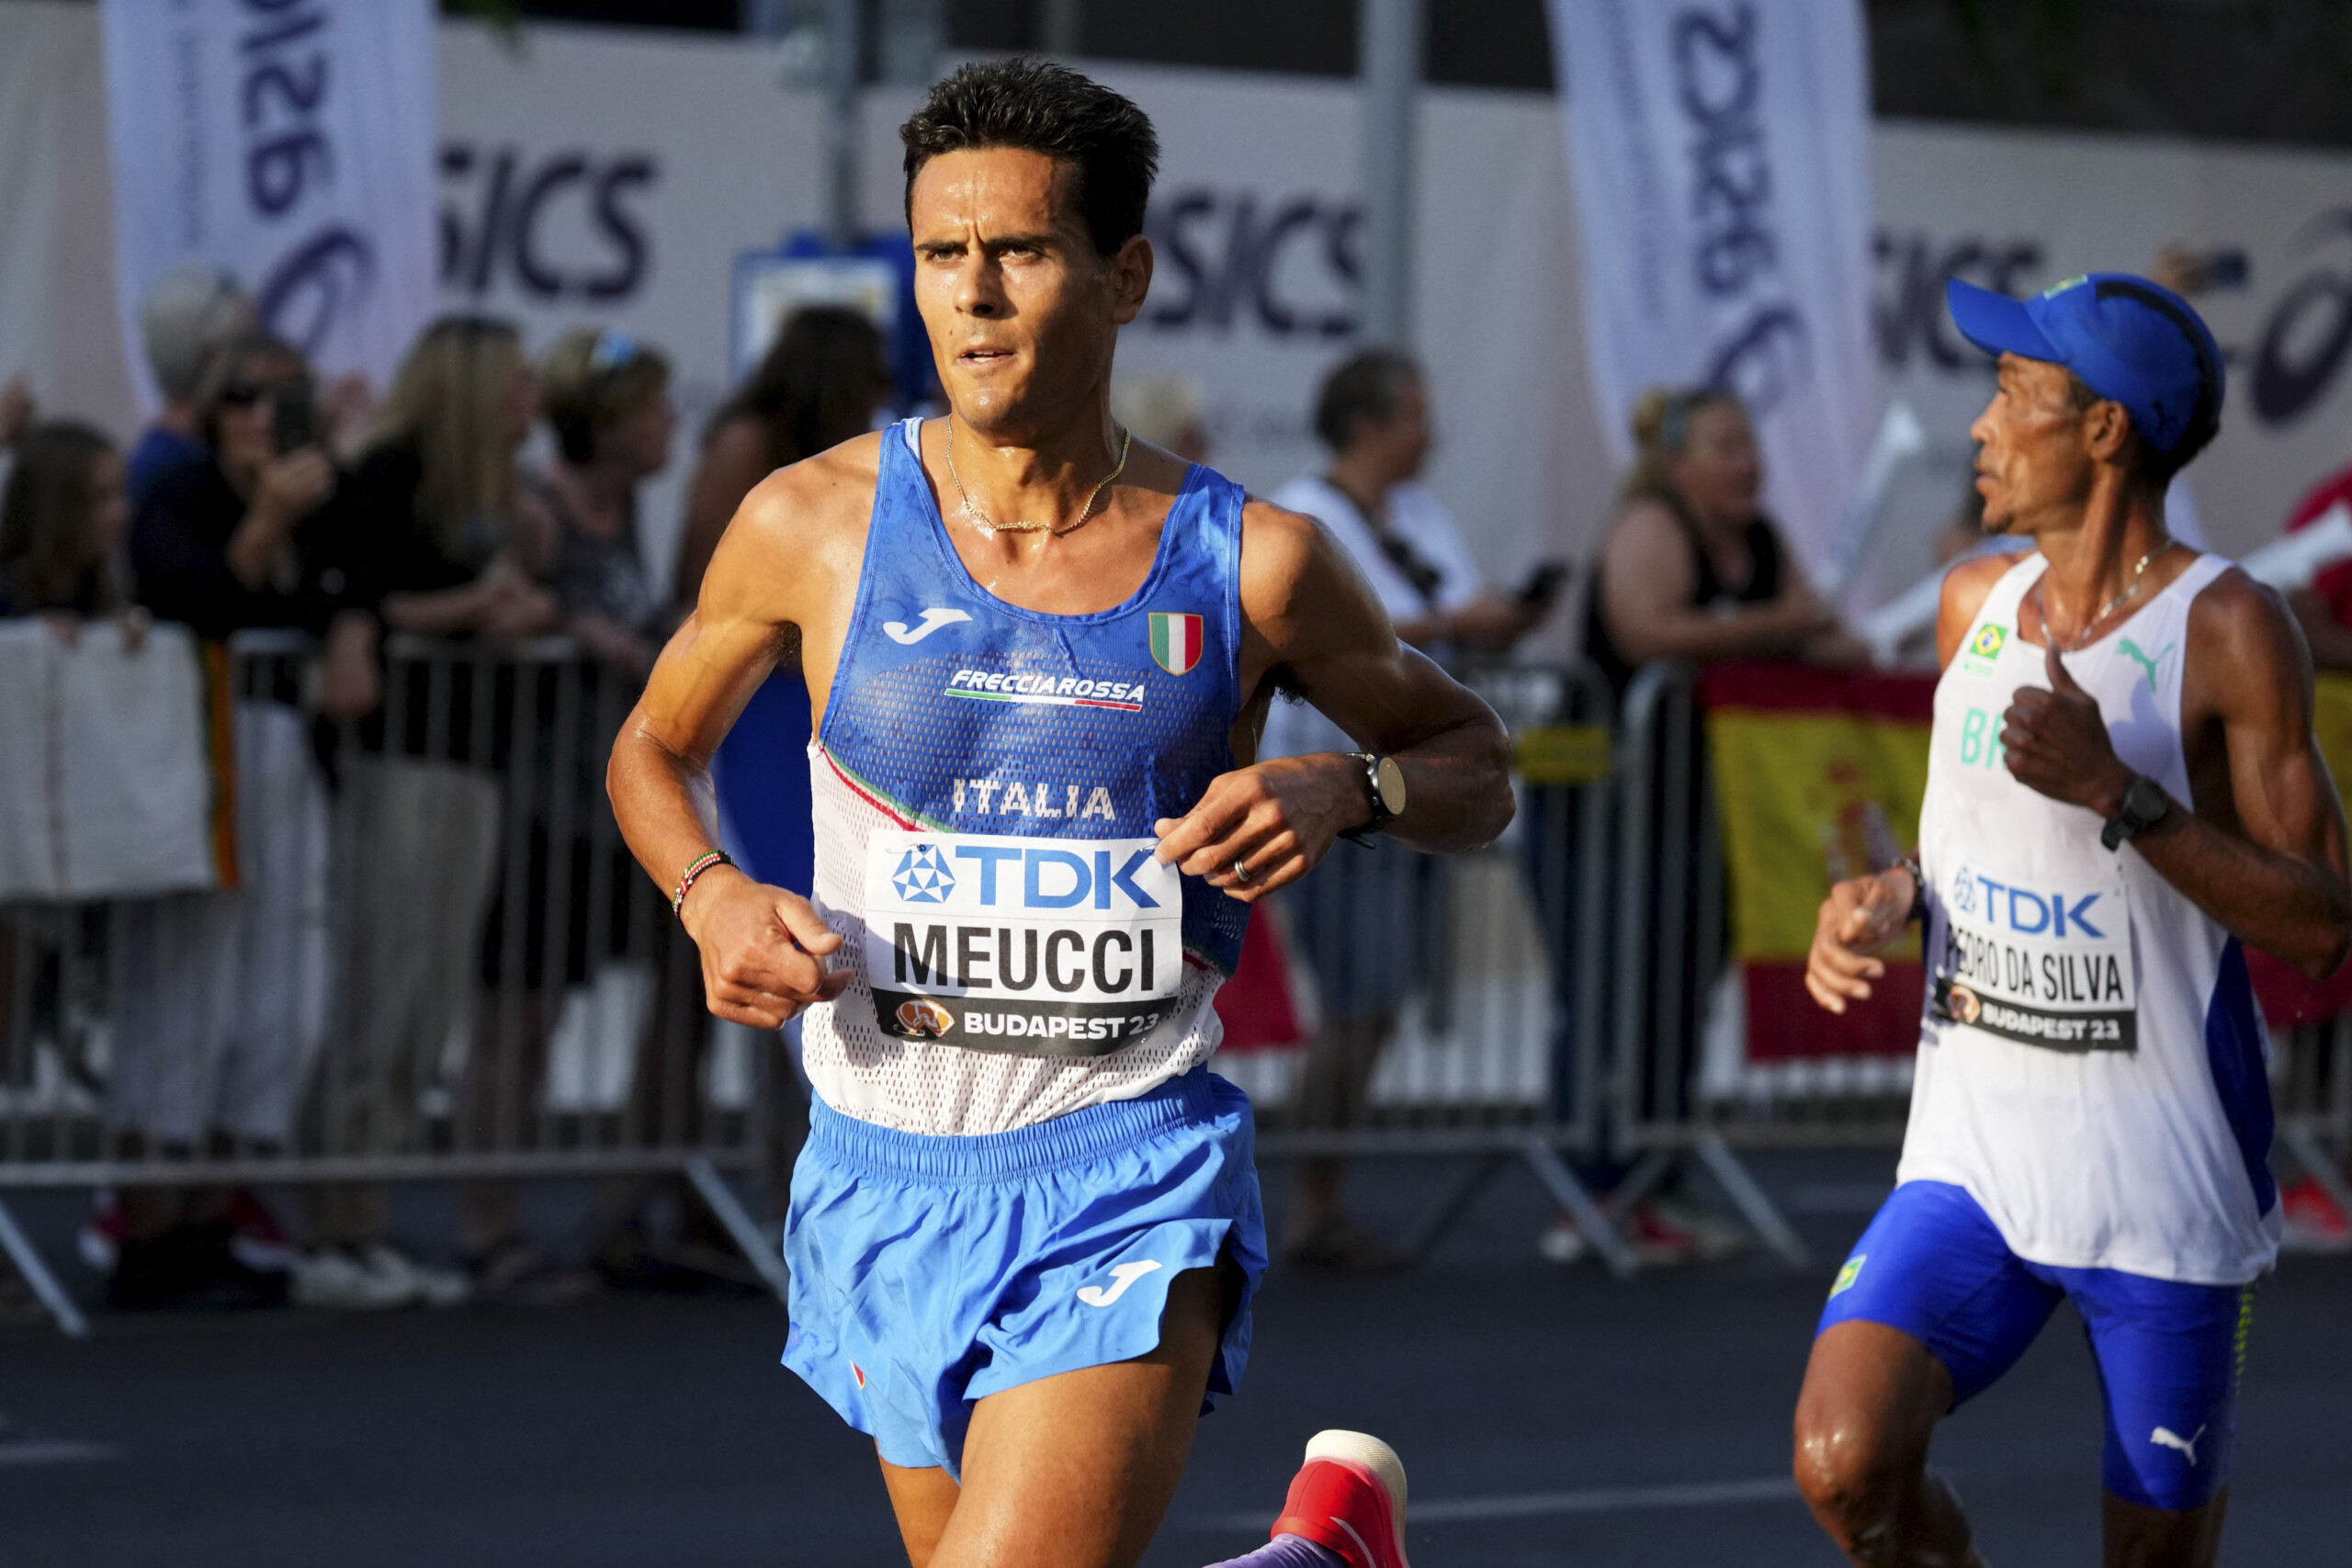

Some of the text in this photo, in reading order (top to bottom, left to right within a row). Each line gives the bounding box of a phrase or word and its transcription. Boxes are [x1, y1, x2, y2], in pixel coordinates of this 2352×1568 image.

[950, 670, 1146, 704] FRECCIAROSSA
[953, 778, 1116, 821] ITALIA
[956, 845, 1162, 909] TDK
[1977, 874, 2106, 940] TDK
[894, 922, 1154, 994] MEUCCI
[2007, 945, 2036, 998] DA
[2041, 953, 2124, 1002] SILVA
[964, 1011, 1159, 1040] BUDAPEST 23
[1981, 1001, 2121, 1041] BUDAPEST 23
